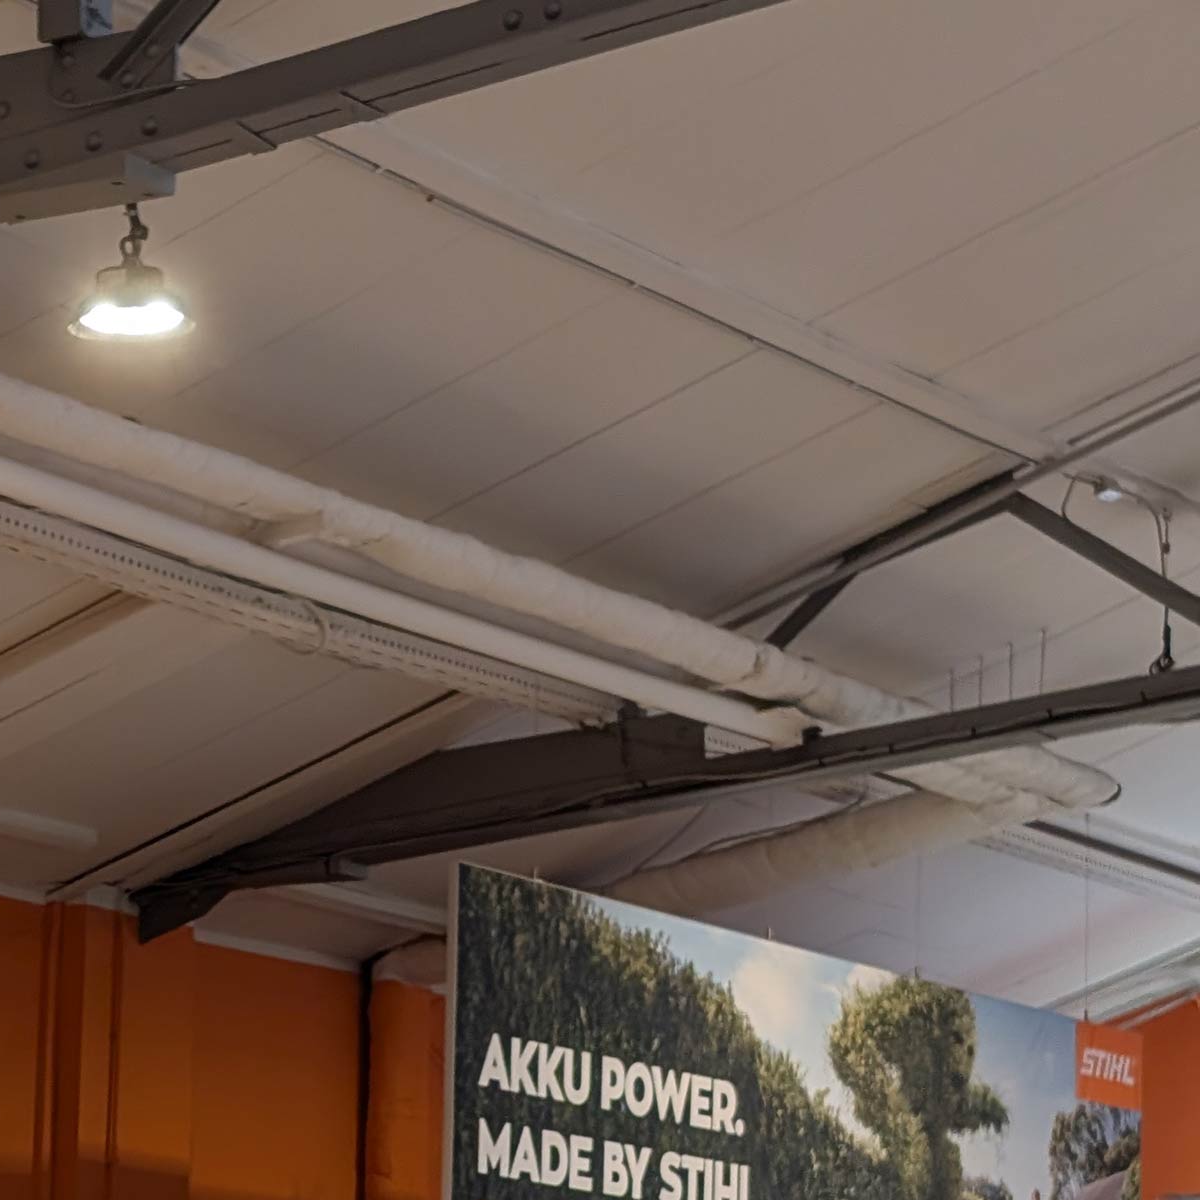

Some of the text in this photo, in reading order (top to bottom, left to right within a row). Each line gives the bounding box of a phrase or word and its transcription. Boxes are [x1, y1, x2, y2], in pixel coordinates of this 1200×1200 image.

[478, 1032, 746, 1137] AKKU POWER.
[1080, 1048, 1135, 1087] STIHL
[477, 1117, 593, 1192] MADE
[602, 1140, 652, 1200] BY
